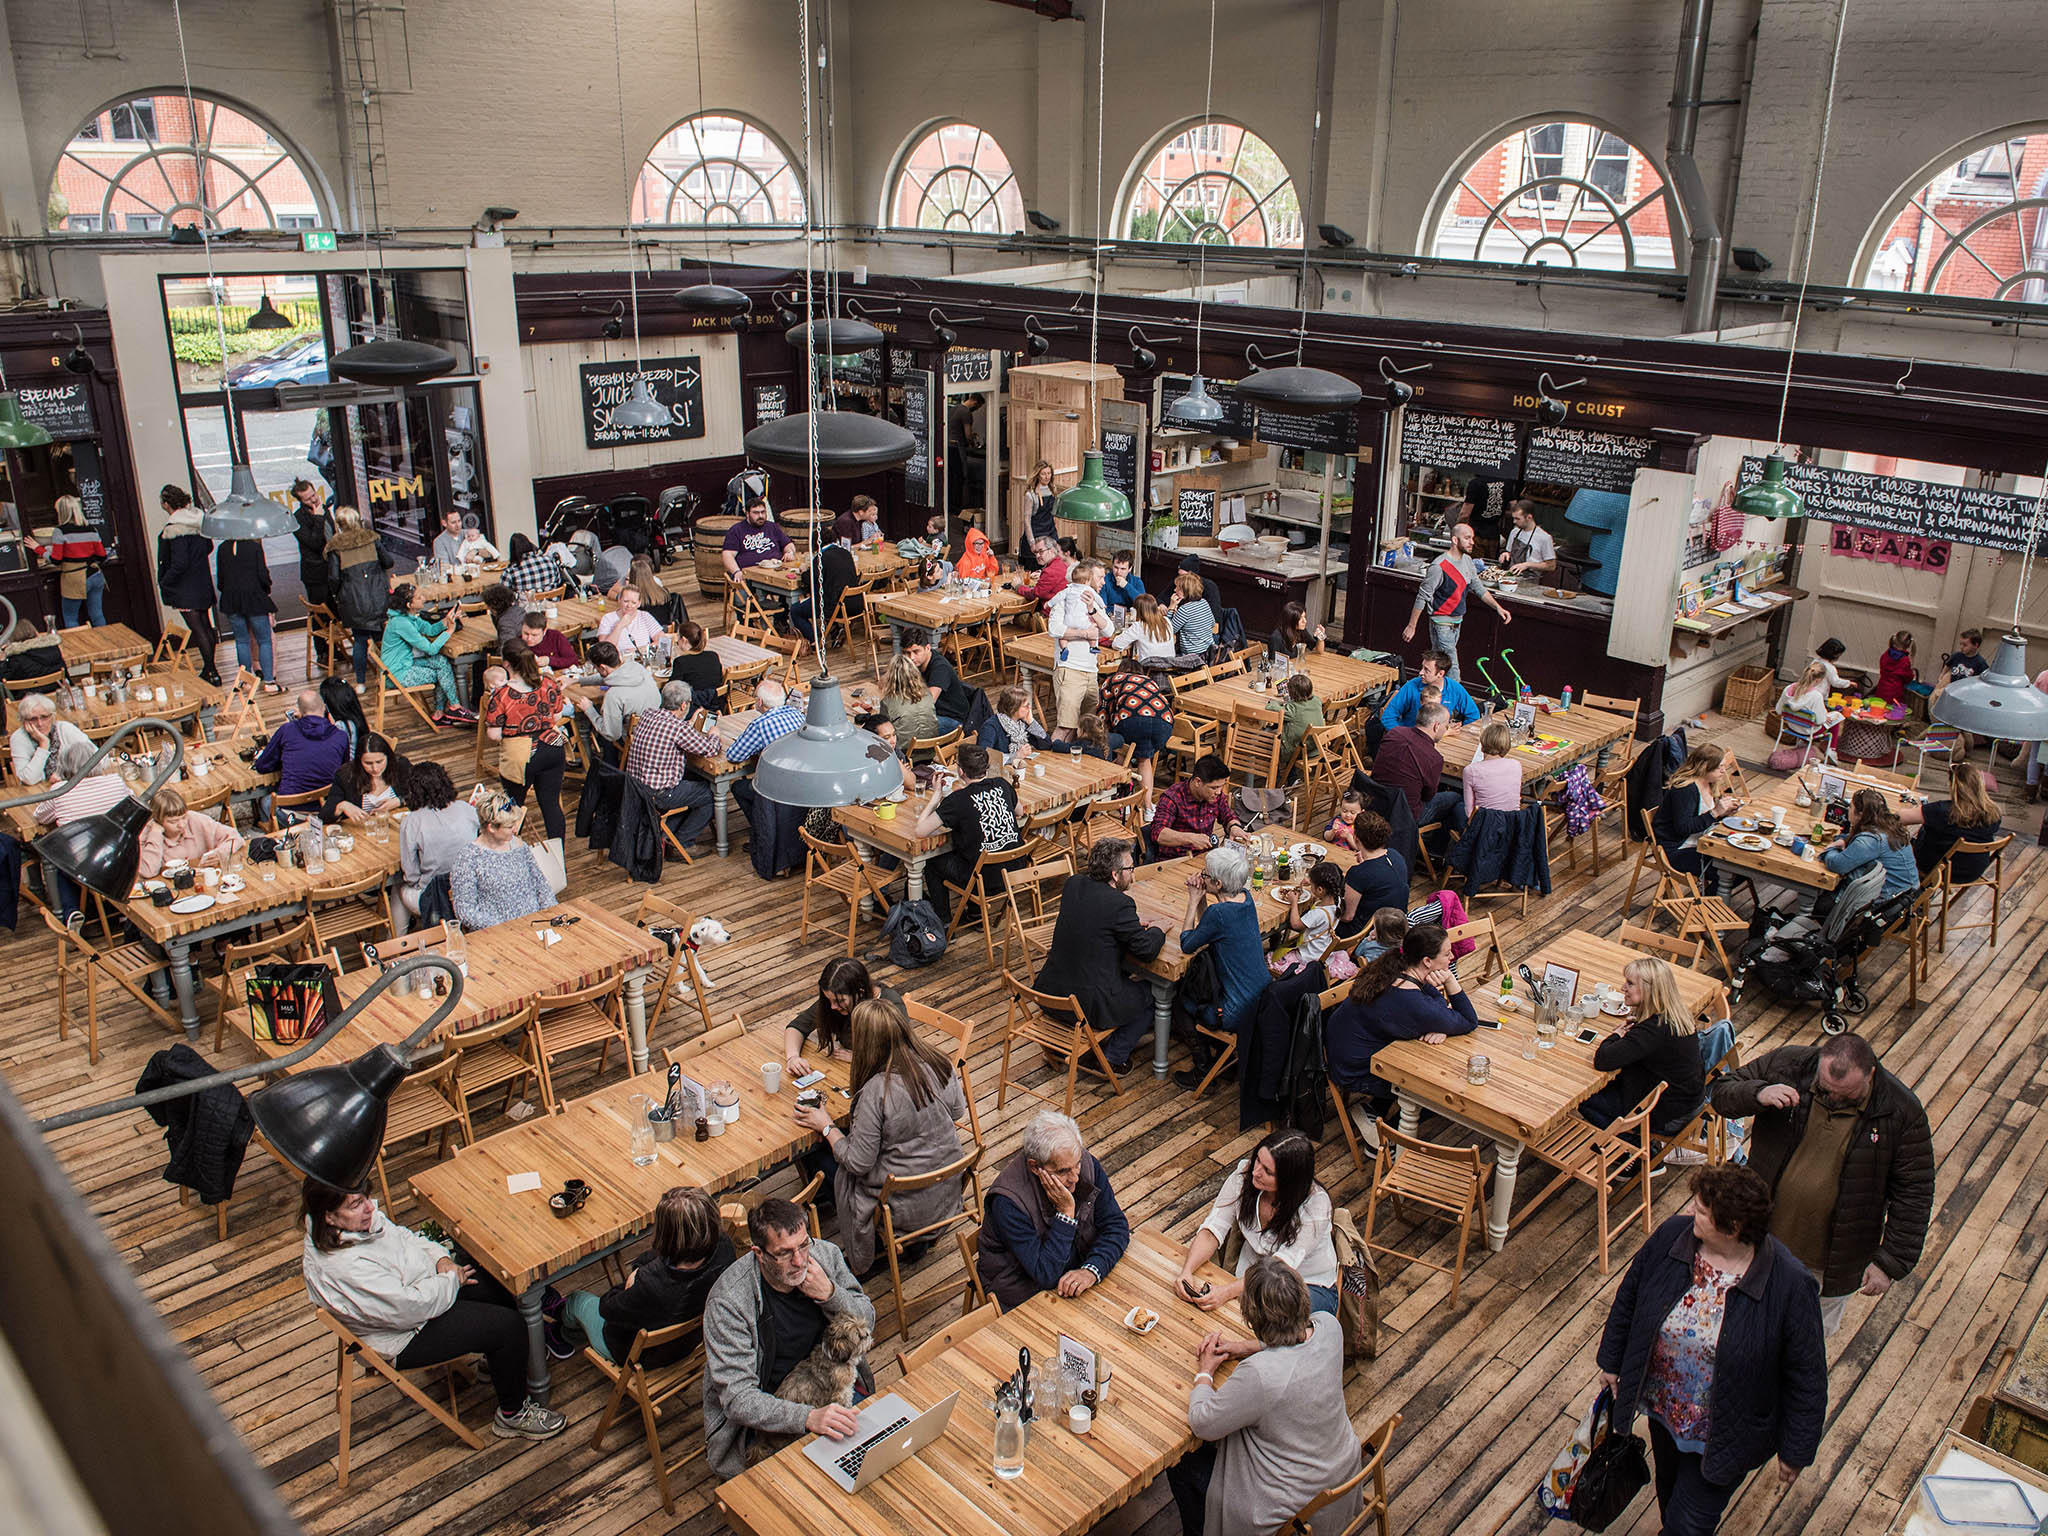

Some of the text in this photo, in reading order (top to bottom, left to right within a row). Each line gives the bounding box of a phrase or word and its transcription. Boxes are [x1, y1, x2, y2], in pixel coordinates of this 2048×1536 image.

[692, 317, 716, 328] JACK
[756, 315, 774, 325] BOX
[529, 327, 535, 336] 7
[51, 356, 60, 367] 6
[592, 386, 633, 408] JUICE
[1415, 386, 1424, 397] 10
[1576, 402, 1625, 418] CRUST
[1404, 421, 1421, 432] LOVE
[1422, 423, 1447, 435] PIZZA
[1420, 414, 1438, 424] ARE
[1438, 415, 1467, 428] HONEST
[1501, 422, 1516, 433] WE
[594, 431, 621, 441] SERVED
[1588, 431, 1624, 447] HONEST
[1625, 437, 1658, 450] CRUST
[1532, 436, 1554, 448] WOOD
[1555, 439, 1581, 454] FIRED
[1582, 442, 1611, 456] PIZZA
[1612, 445, 1647, 459] FACTS:
[1790, 465, 1829, 482] THINGS
[1832, 472, 1879, 489] MARKET
[1881, 477, 1918, 494] HOUSE
[1918, 483, 1928, 498] &
[1930, 485, 1960, 505] ALTY
[1807, 495, 1824, 508] US!
[1925, 512, 1935, 528] &
[1823, 483, 1832, 496] &
[1832, 485, 1862, 498] JUST
[1861, 487, 1870, 499] A
[1871, 489, 1924, 509] GENERAL
[1924, 499, 1962, 522] NOSEY
[1963, 504, 1981, 517] AT
[1982, 507, 2022, 526] WHAT
[1179, 507, 1213, 522] PIZZA!
[1944, 533, 1958, 541] ONE
[1834, 530, 1948, 567] BEARS
[970, 786, 1003, 804] WOOD
[984, 823, 1014, 842] PIZZA
[367, 946, 376, 957] 3
[669, 1065, 680, 1078] 2
